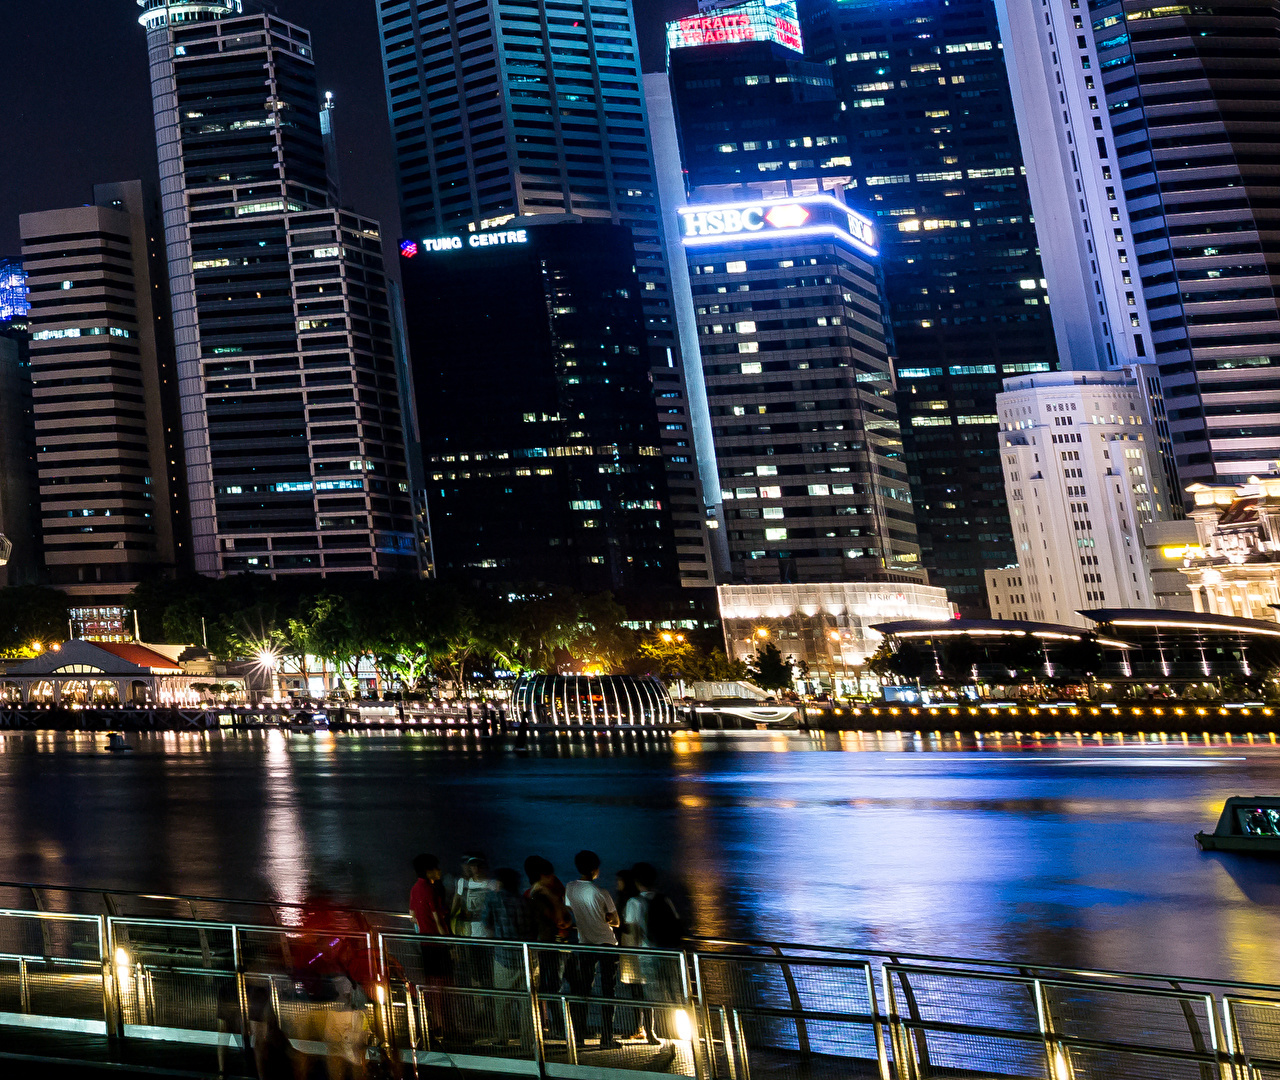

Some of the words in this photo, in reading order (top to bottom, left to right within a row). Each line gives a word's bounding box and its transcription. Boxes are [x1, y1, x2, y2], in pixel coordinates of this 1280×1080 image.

[680, 14, 750, 31] STRAITS
[681, 28, 755, 43] TRADING
[683, 207, 765, 236] HSBC
[422, 236, 462, 251] TUNG
[469, 230, 527, 247] CENTRE
